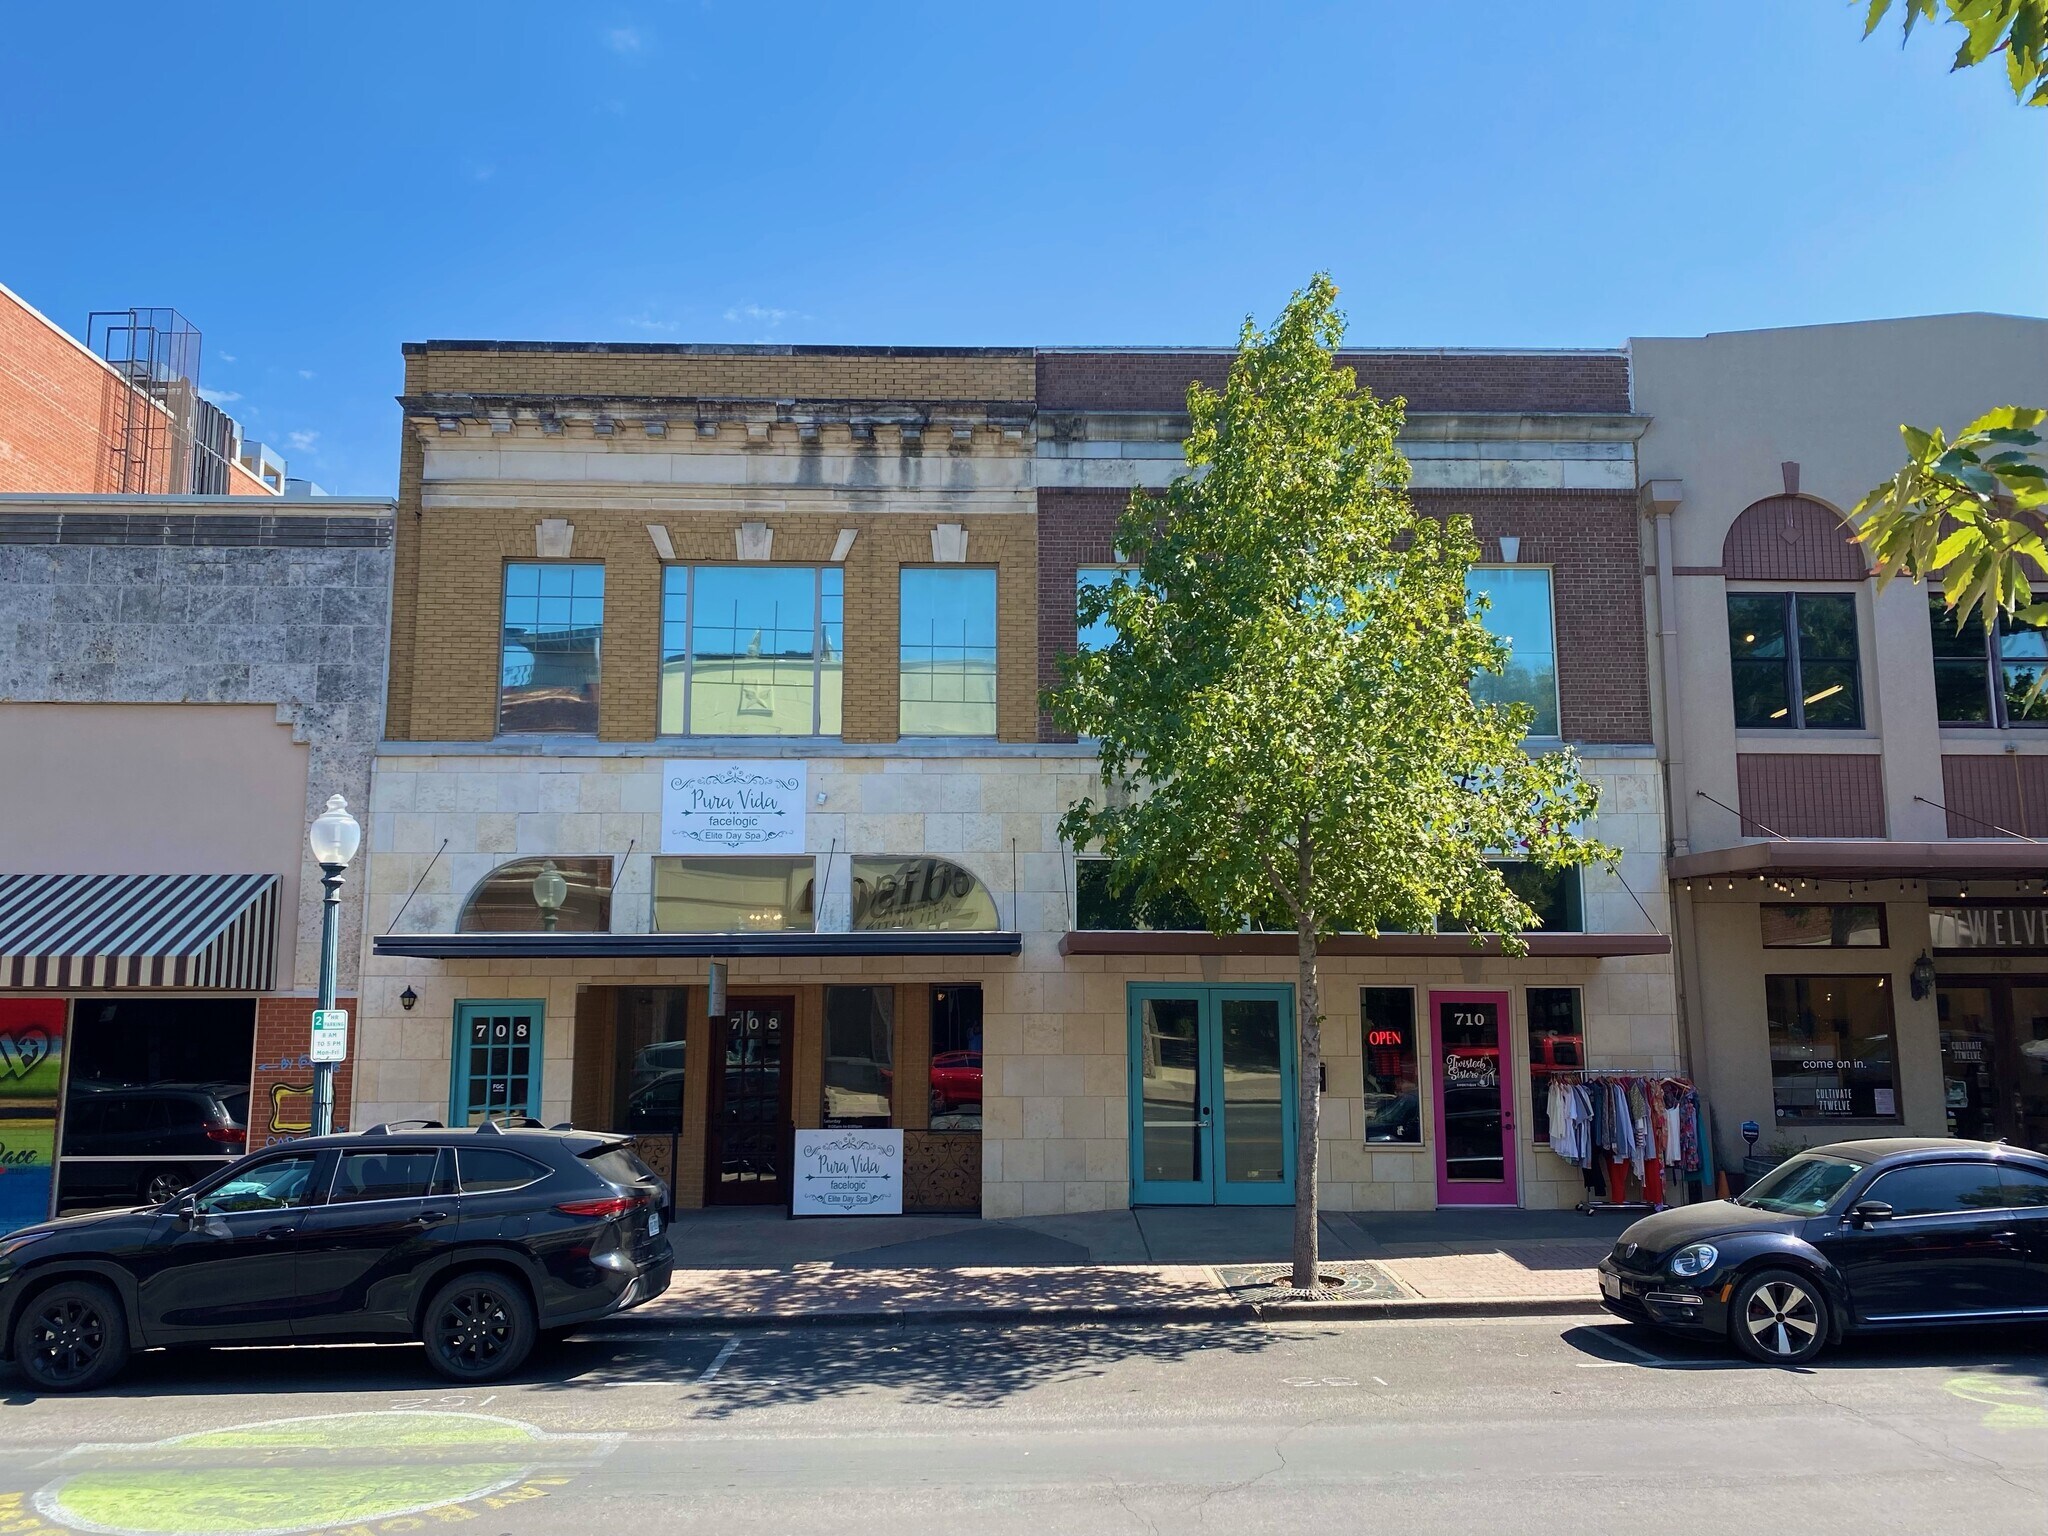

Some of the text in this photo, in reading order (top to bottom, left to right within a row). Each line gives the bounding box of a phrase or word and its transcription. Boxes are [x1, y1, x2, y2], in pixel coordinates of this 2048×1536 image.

[691, 788, 778, 810] Pura Vida
[709, 816, 758, 829] facelogic
[705, 832, 761, 842] Elite Day Spa
[315, 1016, 322, 1026] 2
[730, 1017, 778, 1030] 708
[1454, 1013, 1485, 1026] 710
[475, 1024, 528, 1037] 708
[1369, 1031, 1402, 1045] OPEN
[1952, 1042, 1982, 1050] CULTIVATE
[1446, 1054, 1486, 1070] Twisted
[1802, 1059, 1867, 1069] come on in.
[1448, 1066, 1480, 1081] Sisters
[1816, 1089, 1852, 1099] CULTIVATE
[1820, 1100, 1851, 1110] 7TWELVE
[818, 1154, 880, 1174] Pura Vida
[831, 1181, 866, 1192] facelogic
[828, 1195, 868, 1204] Elite Day Spa
